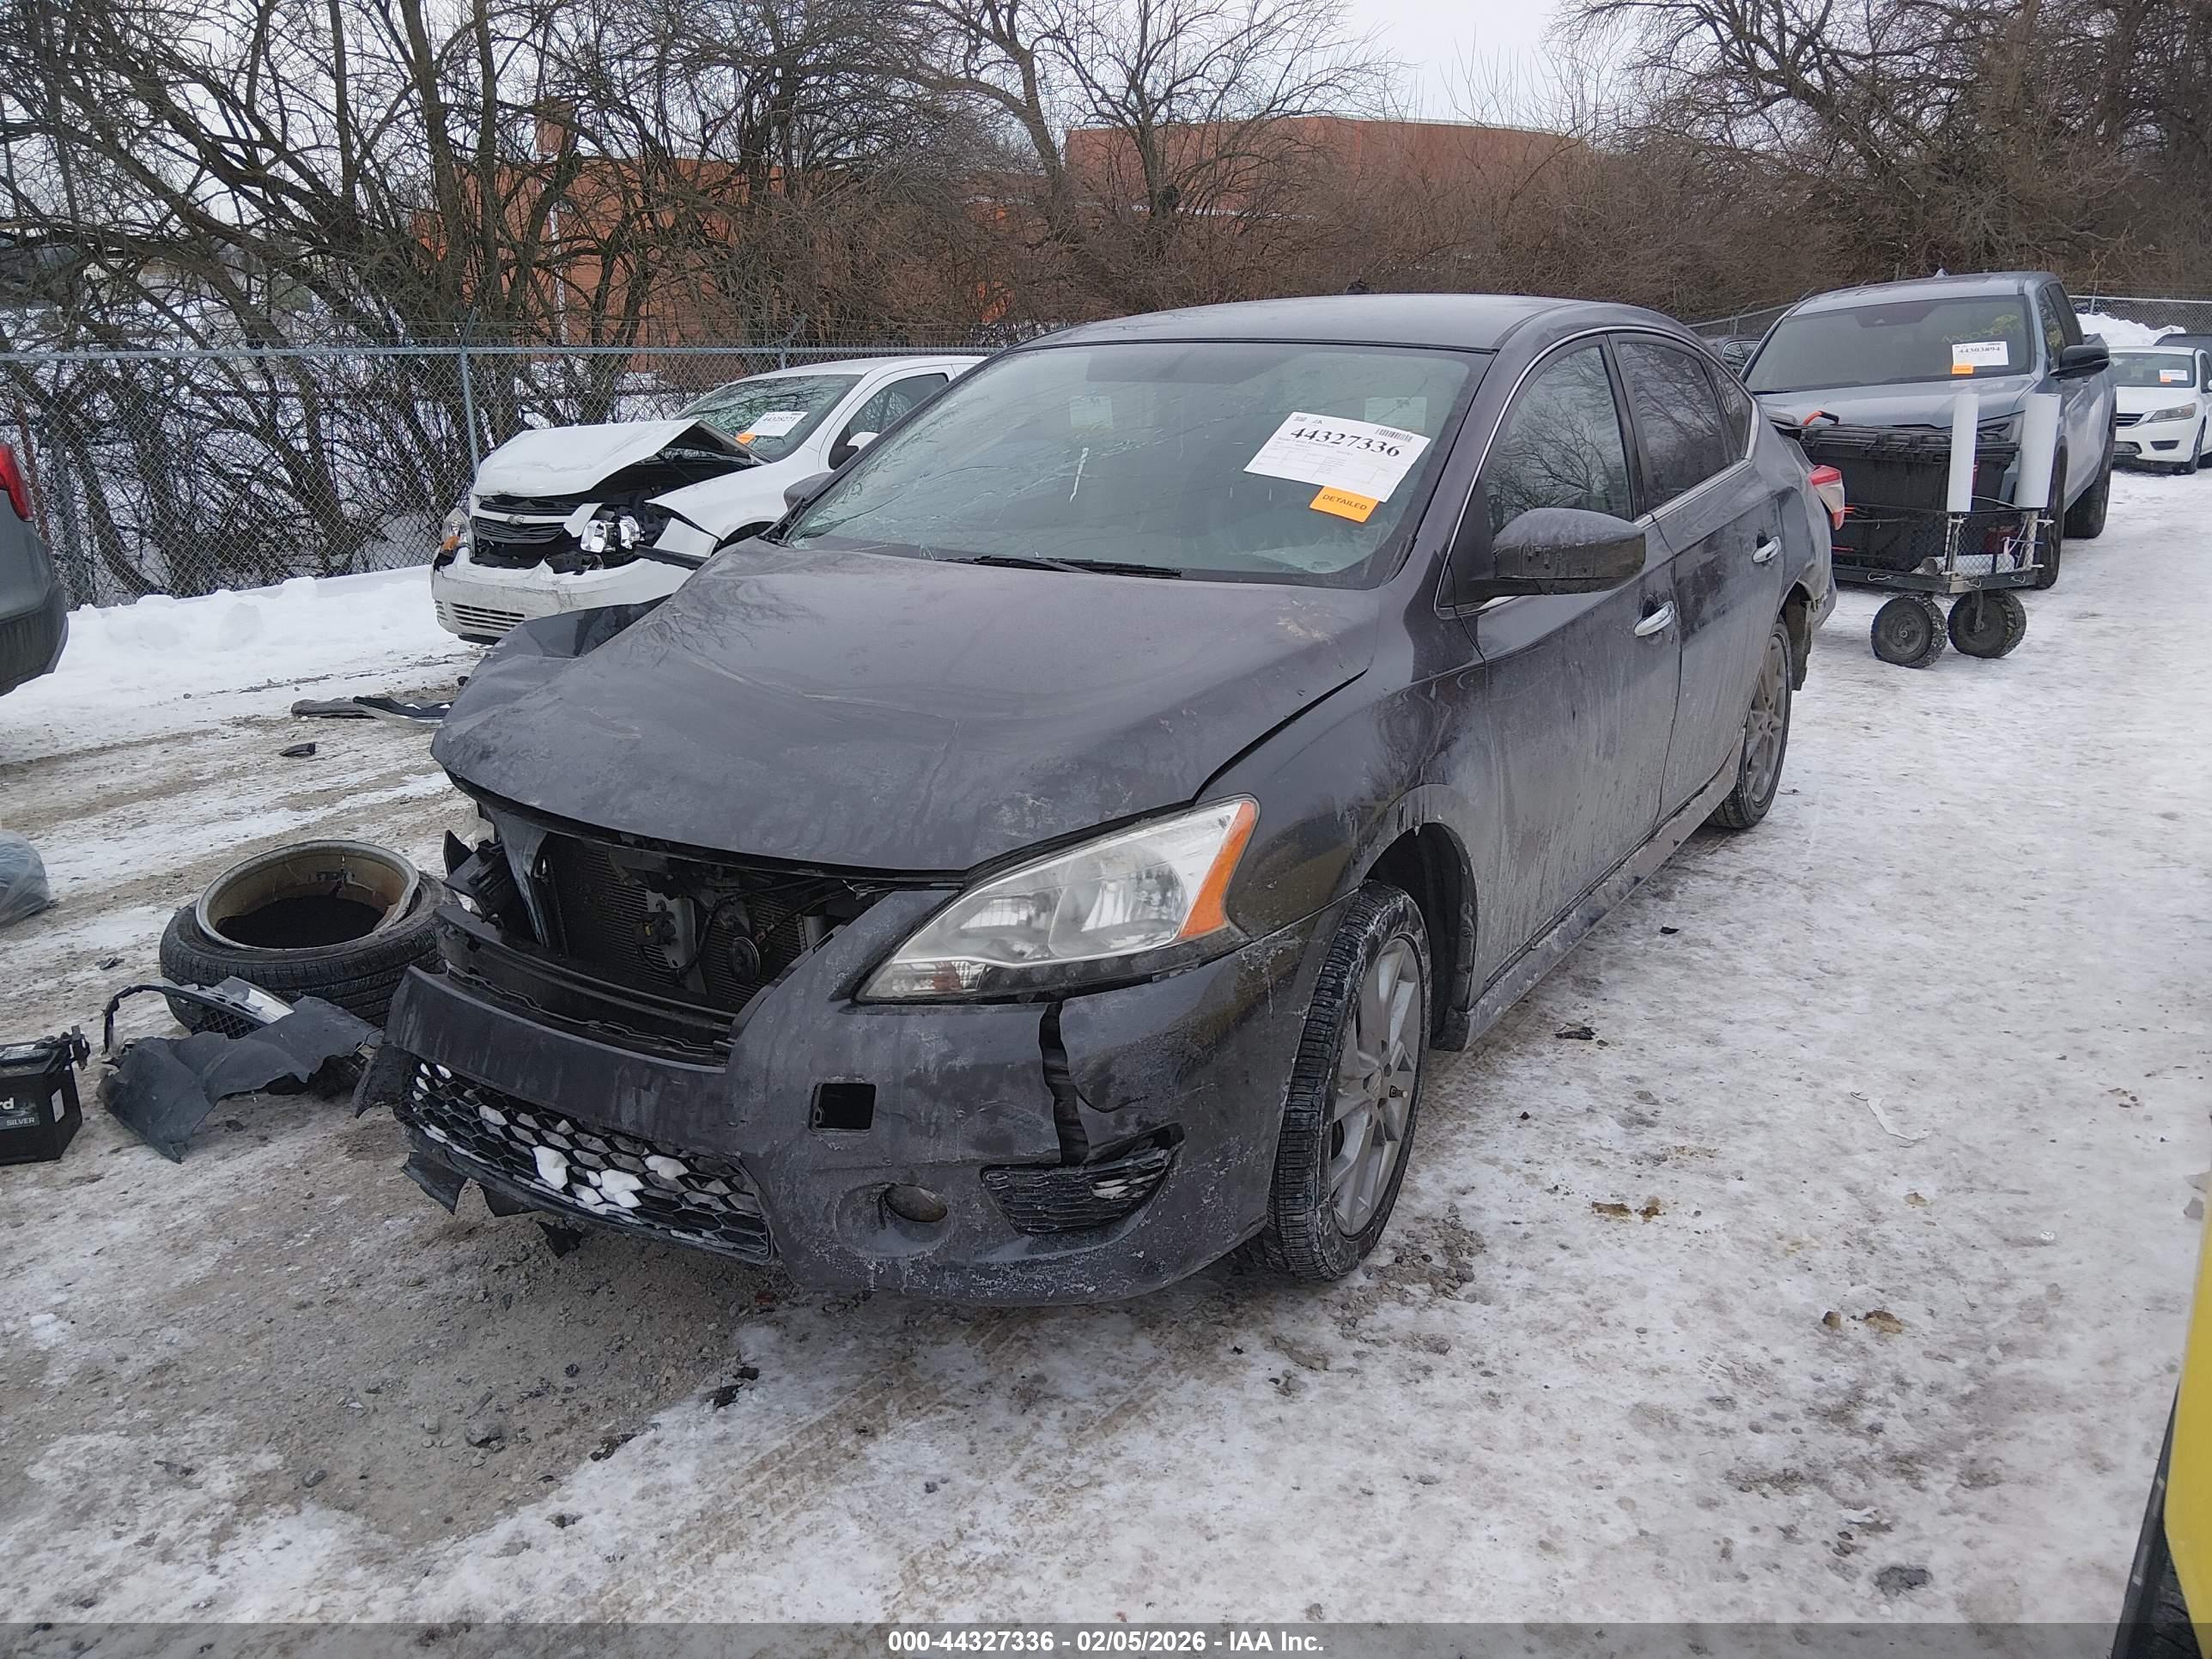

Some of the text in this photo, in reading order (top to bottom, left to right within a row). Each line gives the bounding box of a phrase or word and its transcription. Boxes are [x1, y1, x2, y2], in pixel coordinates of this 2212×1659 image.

[1291, 428, 1405, 457] 44327336
[1322, 494, 1367, 511] DETAILED
[6, 1116, 35, 1127] SILVER
